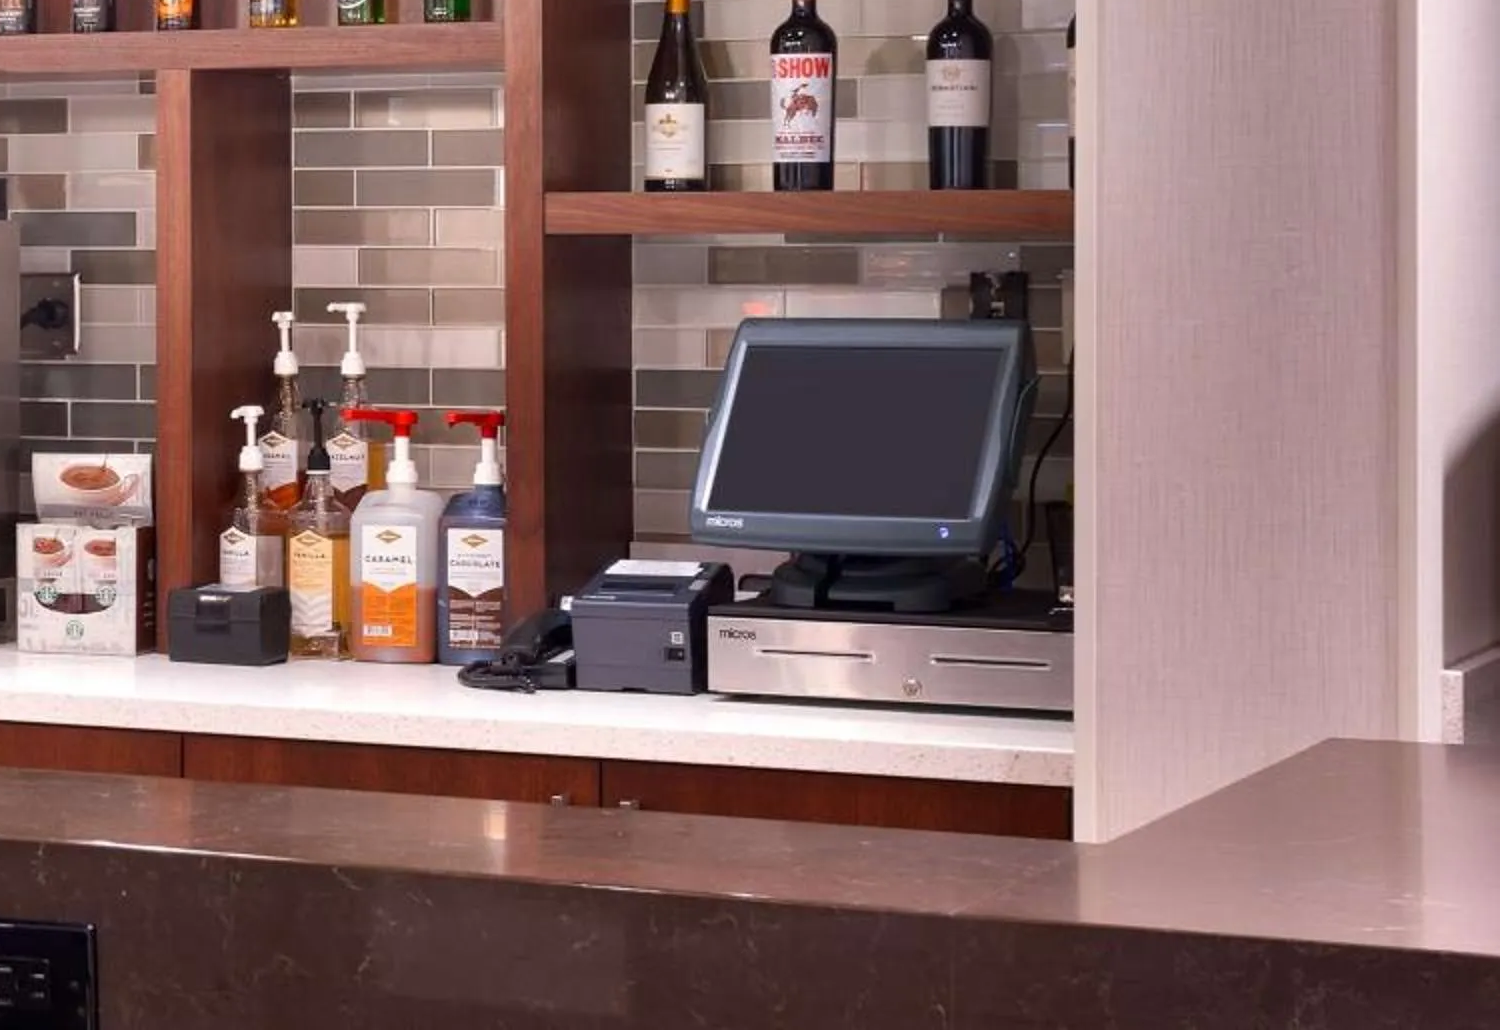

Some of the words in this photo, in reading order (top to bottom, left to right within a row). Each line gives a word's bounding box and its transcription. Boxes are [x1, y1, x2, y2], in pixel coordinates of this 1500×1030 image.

[778, 57, 830, 79] SHOW
[364, 555, 413, 565] CARAMEL
[449, 559, 501, 569] CHOCOLATE
[718, 627, 757, 641] micros
